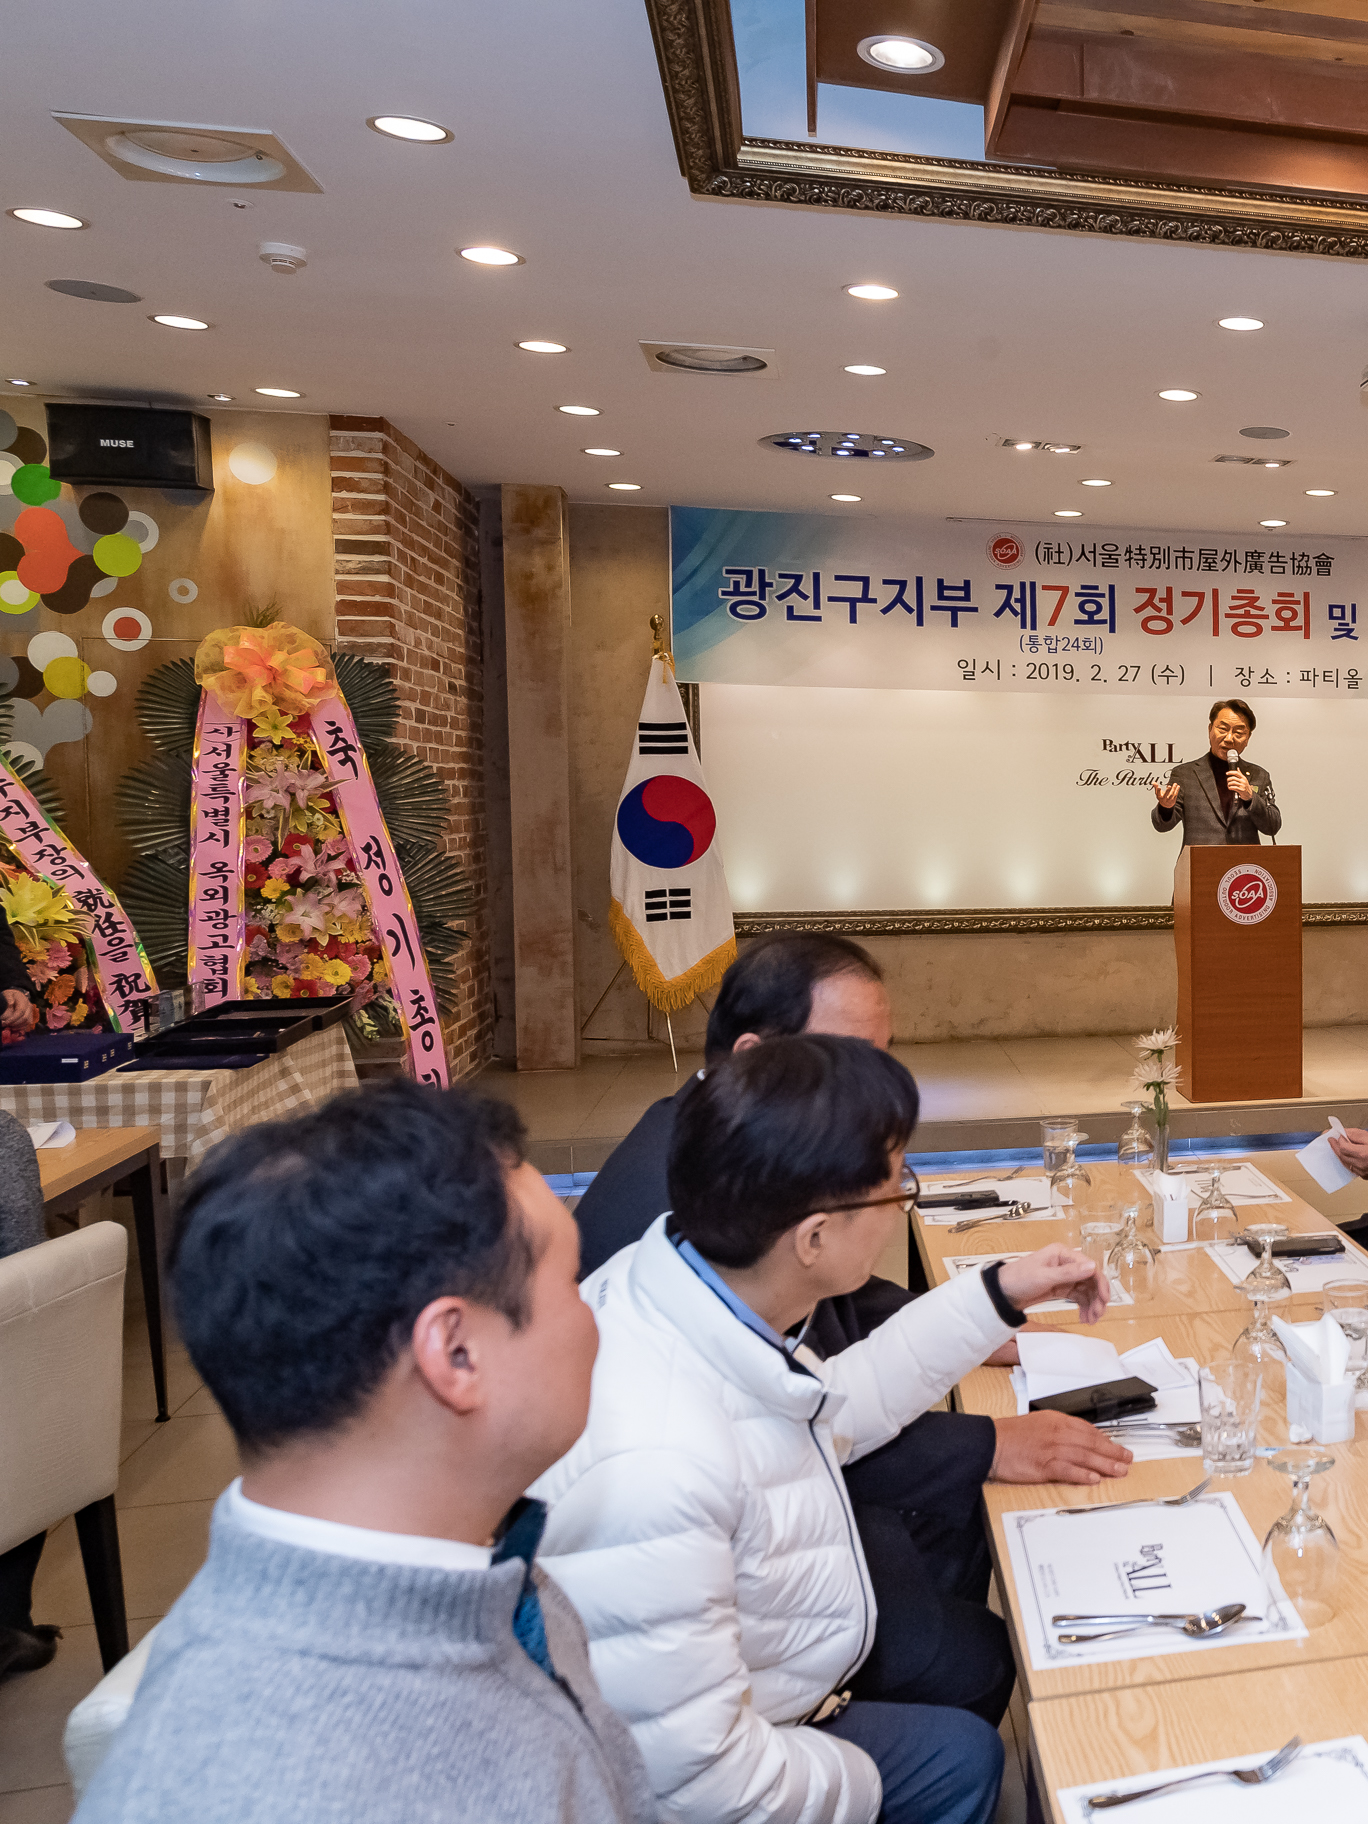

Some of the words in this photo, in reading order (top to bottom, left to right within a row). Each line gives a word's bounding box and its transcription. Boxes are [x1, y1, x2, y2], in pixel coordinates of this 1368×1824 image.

[100, 439, 134, 448] MUSE
[719, 567, 979, 628] 광진구지부
[993, 580, 1117, 633] 제7회
[1132, 586, 1311, 639] 정기총회
[1327, 602, 1360, 641] 및
[1018, 634, 1104, 655] (통합24회)
[957, 658, 1001, 682] 일시
[1026, 662, 1080, 683] 2019.
[1090, 664, 1108, 683] 2.
[1117, 664, 1141, 683] 27
[1151, 663, 1186, 686] (수)
[1234, 665, 1278, 687] 장소
[1298, 667, 1364, 690] 파티올
[324, 720, 359, 780] 축
[1101, 738, 1143, 753] Party
[1126, 742, 1184, 764] ALL
[1075, 768, 1110, 787] The
[1231, 889, 1264, 900] SOAA
[1234, 904, 1270, 921] ADVERTISING
[196, 861, 238, 999] 옥외광고협회
